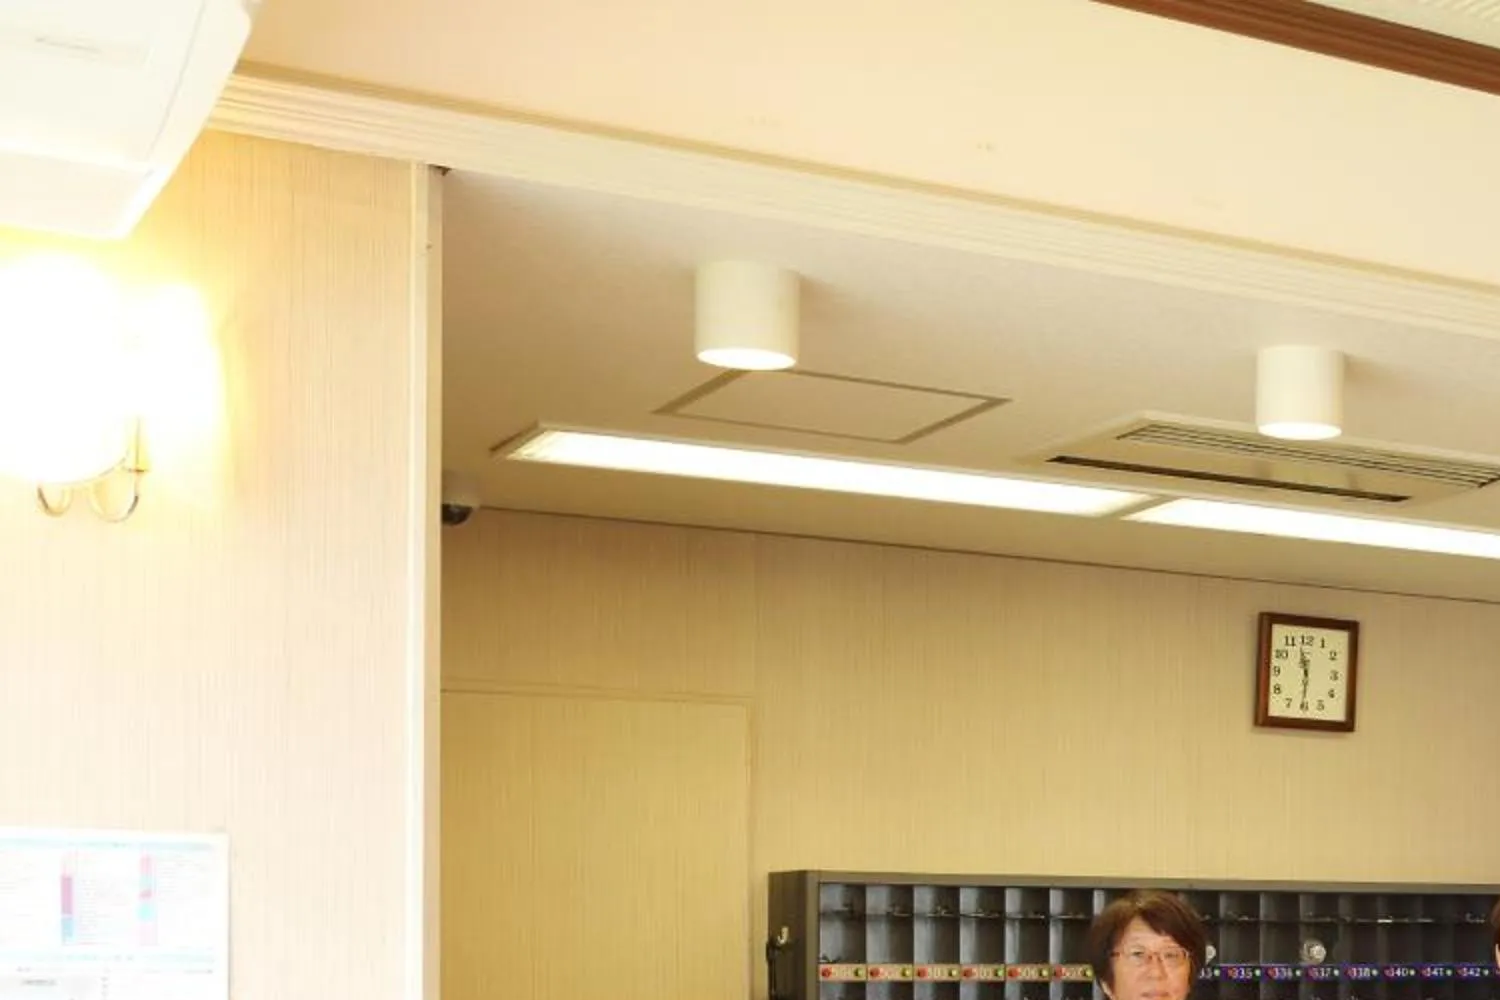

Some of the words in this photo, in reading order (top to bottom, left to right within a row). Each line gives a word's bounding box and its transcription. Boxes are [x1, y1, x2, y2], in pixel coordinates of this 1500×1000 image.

[1284, 635, 1296, 646] 11
[1300, 635, 1314, 646] 12
[1275, 649, 1288, 659] 10
[1329, 651, 1337, 660] 2
[1273, 666, 1280, 676] 9
[1329, 671, 1338, 681] 3
[1274, 684, 1281, 694] 8
[1328, 689, 1335, 698] 4
[1285, 698, 1292, 708] 7
[1317, 700, 1325, 710] 5
